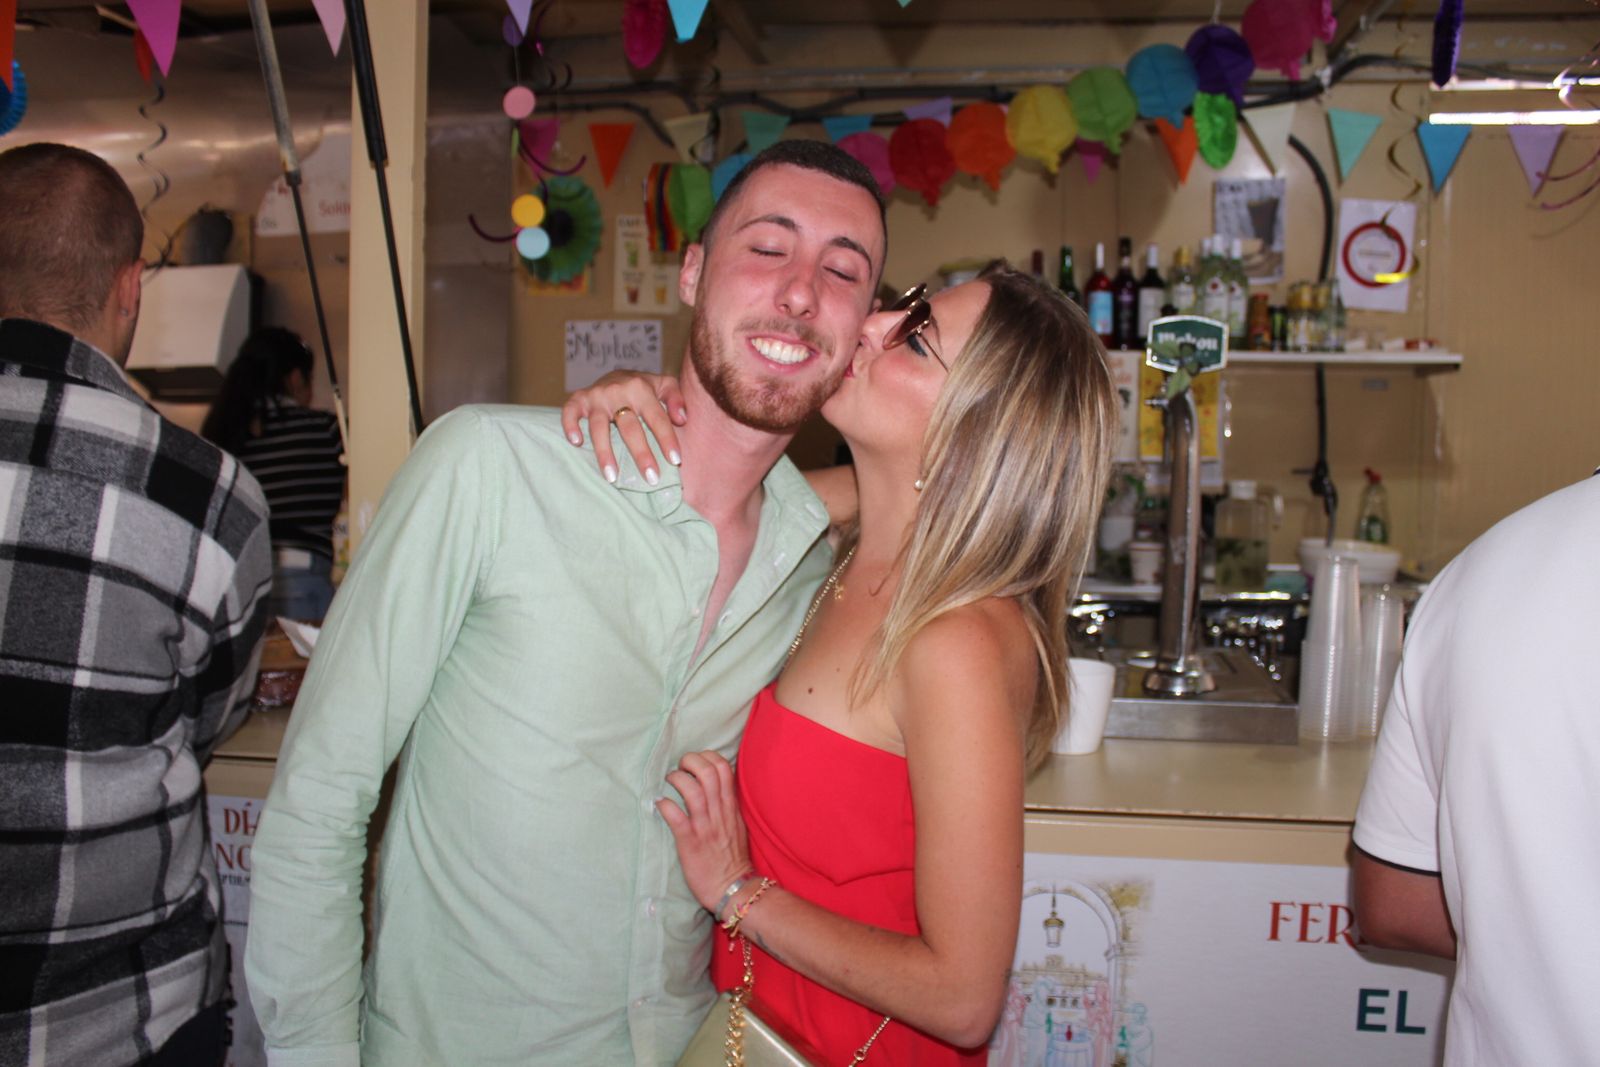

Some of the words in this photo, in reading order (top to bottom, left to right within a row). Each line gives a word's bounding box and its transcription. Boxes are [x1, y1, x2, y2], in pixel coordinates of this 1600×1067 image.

[574, 332, 643, 366] Mojitos
[1267, 901, 1362, 952] FER
[1356, 988, 1426, 1034] EL
